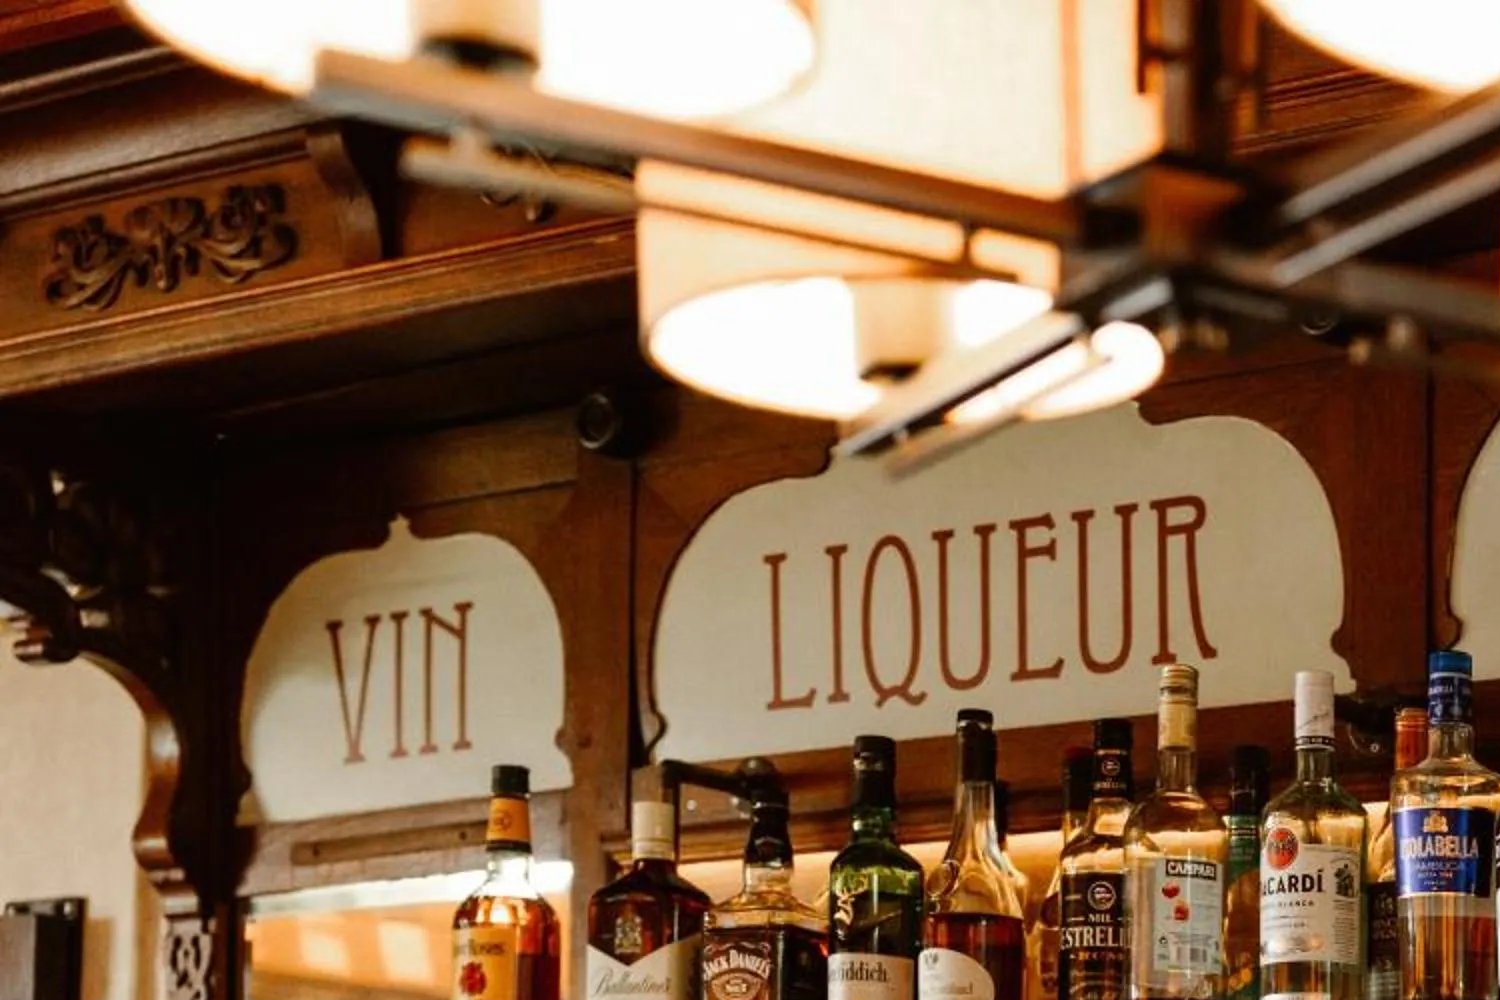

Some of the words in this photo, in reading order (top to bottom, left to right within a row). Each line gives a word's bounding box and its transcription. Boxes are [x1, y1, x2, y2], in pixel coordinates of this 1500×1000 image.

[763, 495, 1218, 711] LIQUEUR
[326, 602, 474, 766] VIN
[1167, 861, 1216, 879] CAMPARI
[1262, 869, 1325, 896] CARDÍ
